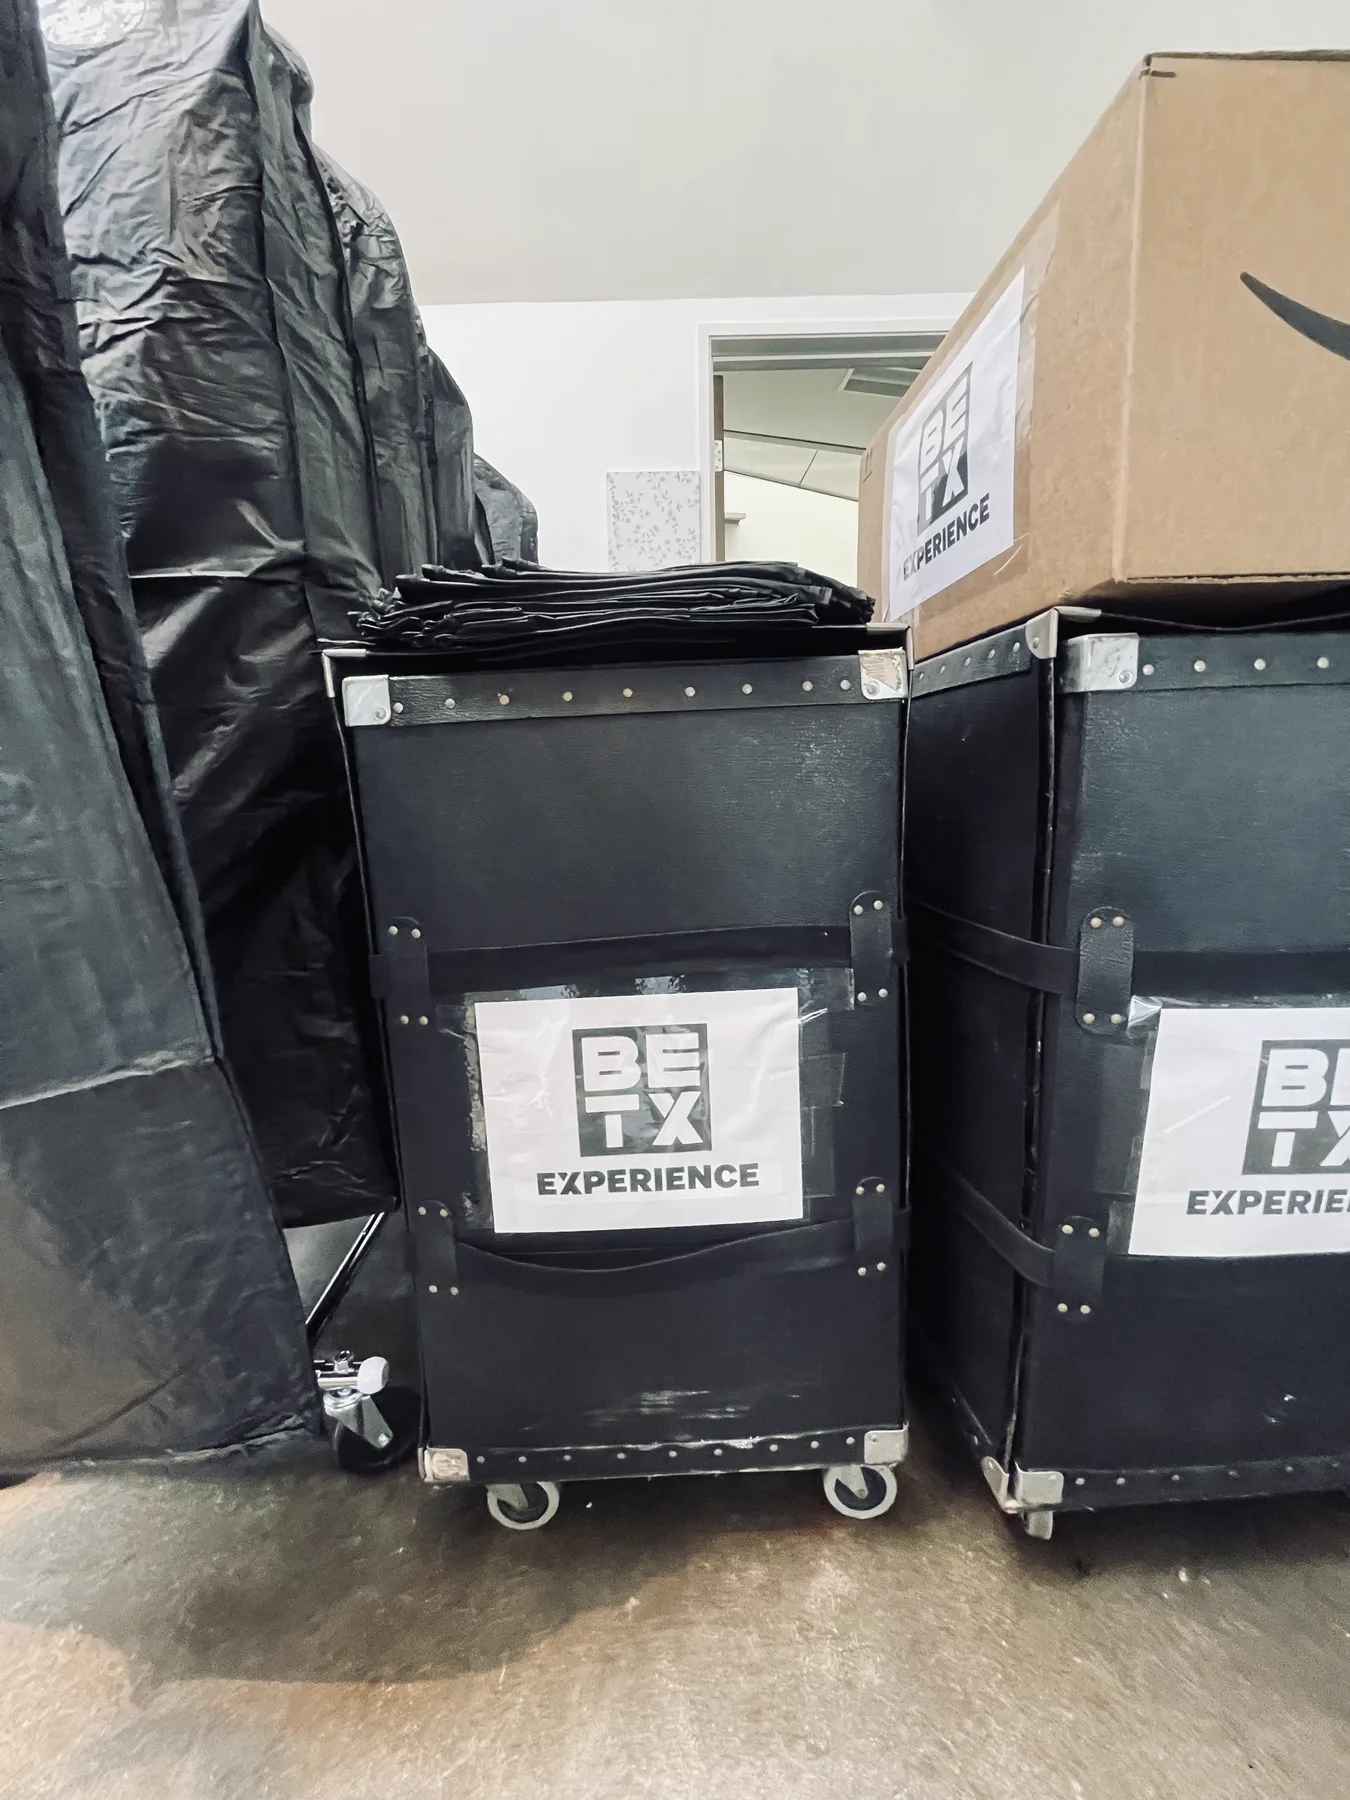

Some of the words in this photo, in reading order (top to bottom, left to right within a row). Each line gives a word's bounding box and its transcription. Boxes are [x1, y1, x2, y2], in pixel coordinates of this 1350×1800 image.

[920, 371, 969, 476] BE
[919, 441, 966, 521] TX
[903, 492, 990, 581] EXPERIENCE
[581, 1032, 701, 1092] BE
[585, 1091, 704, 1148] TX
[537, 1163, 759, 1195] EXPERIENCE
[1186, 1189, 1350, 1215] EXPERIE
